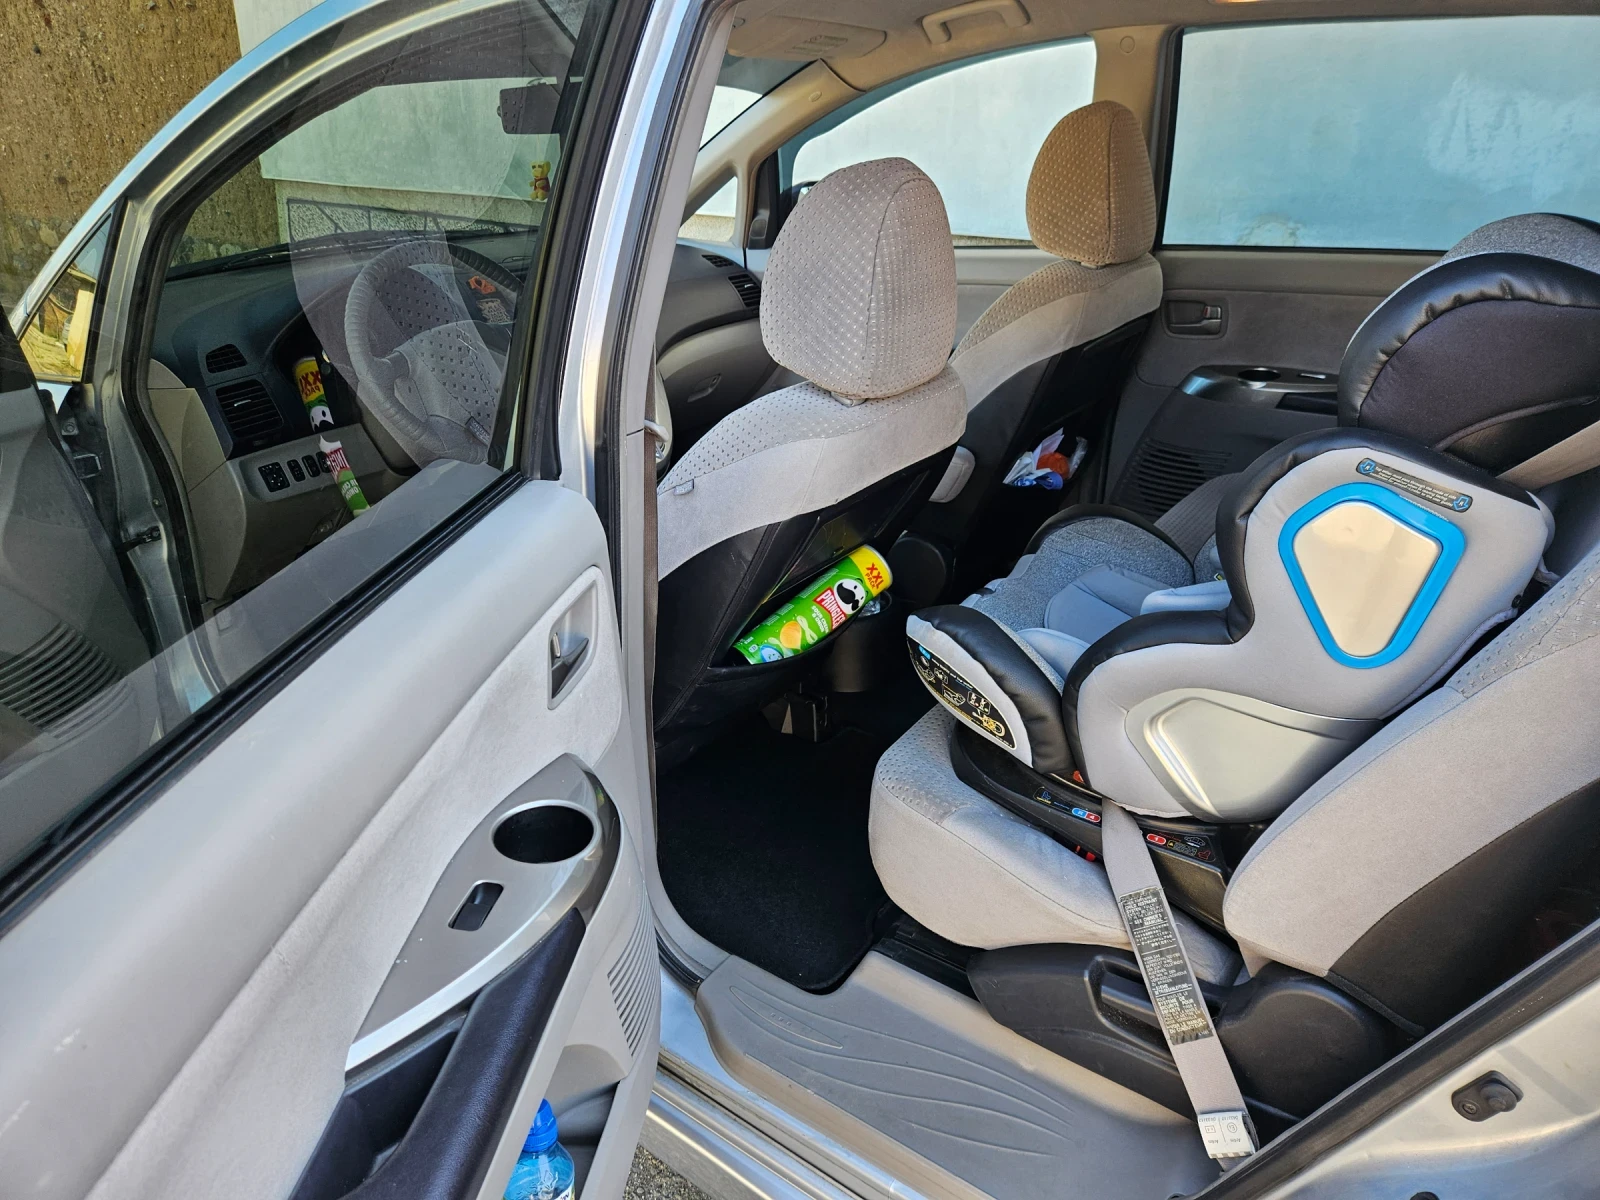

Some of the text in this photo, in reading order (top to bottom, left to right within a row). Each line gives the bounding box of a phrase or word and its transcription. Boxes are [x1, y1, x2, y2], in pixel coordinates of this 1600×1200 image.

[865, 562, 884, 589] XXL
[865, 572, 876, 589] PACK
[811, 606, 823, 619] SOUR
[815, 589, 846, 630] PRINGLES
